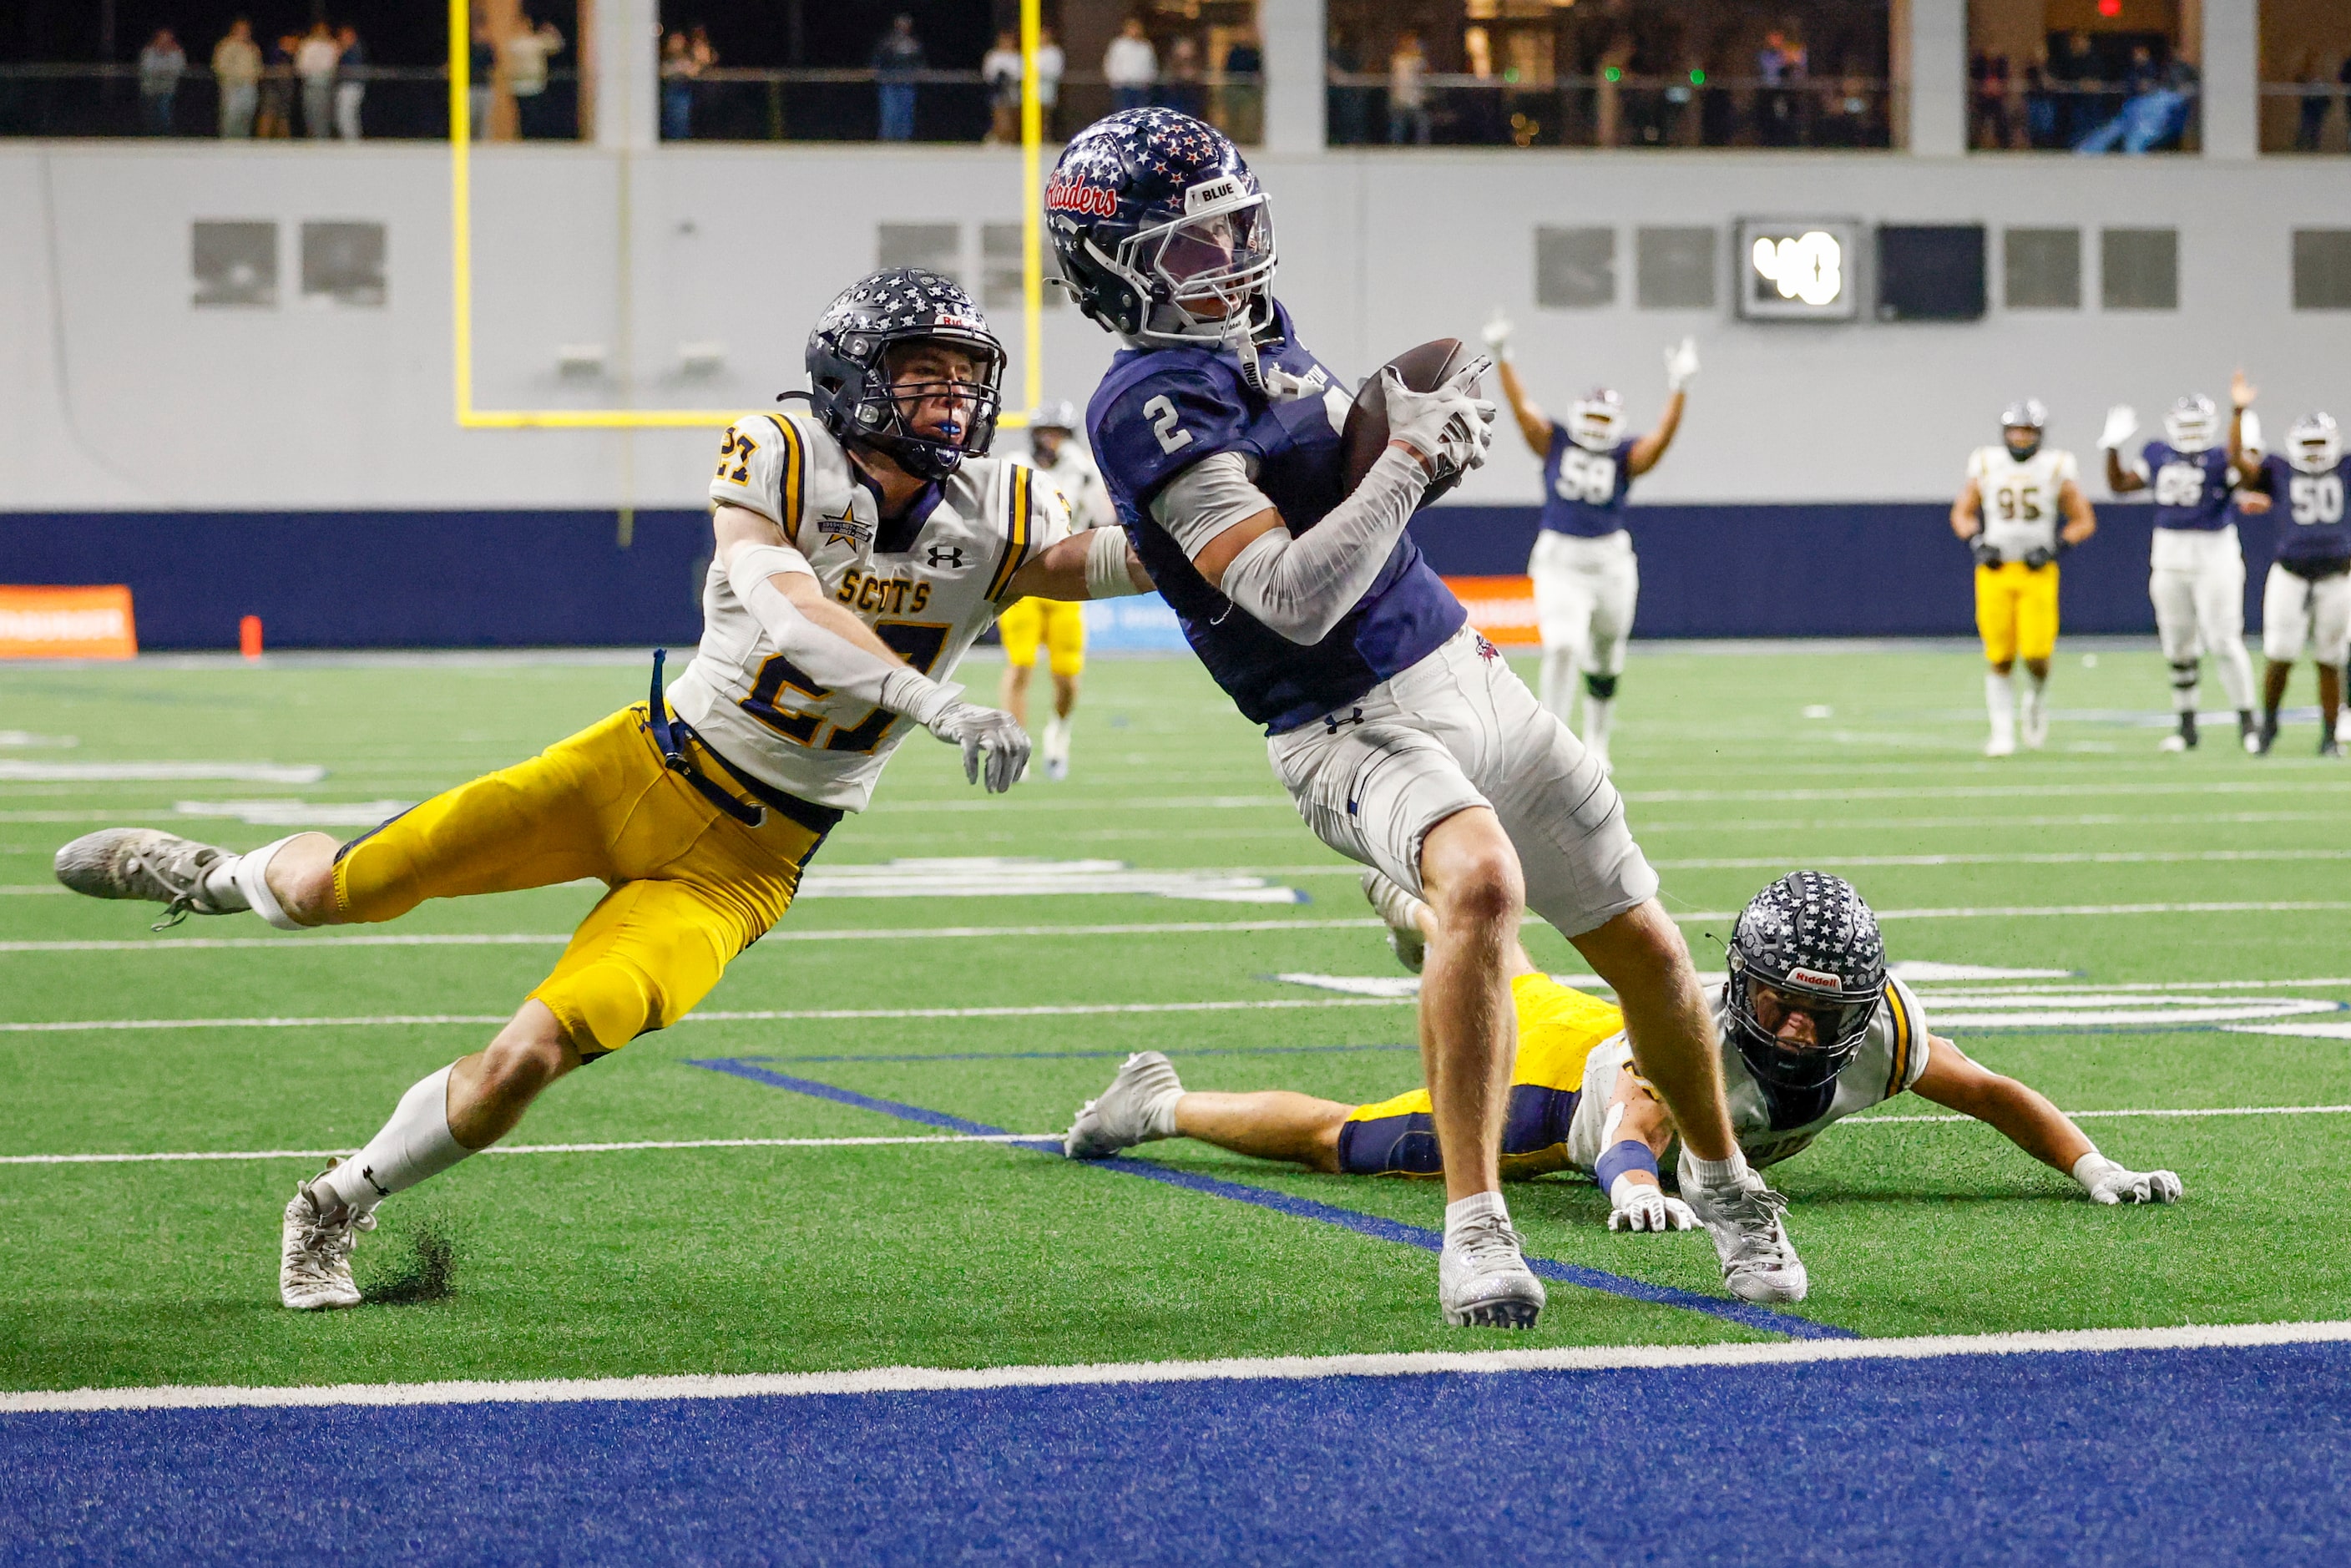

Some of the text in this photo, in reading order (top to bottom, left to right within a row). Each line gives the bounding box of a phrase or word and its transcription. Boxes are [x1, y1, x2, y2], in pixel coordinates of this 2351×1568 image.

[1045, 171, 1118, 220] Raiders
[1202, 183, 1234, 202] BLUE
[1143, 394, 1193, 455] 2
[714, 425, 761, 488] 27
[2290, 476, 2343, 524] 50
[837, 568, 932, 615] SCOTS
[1796, 972, 1838, 988] Riddell
